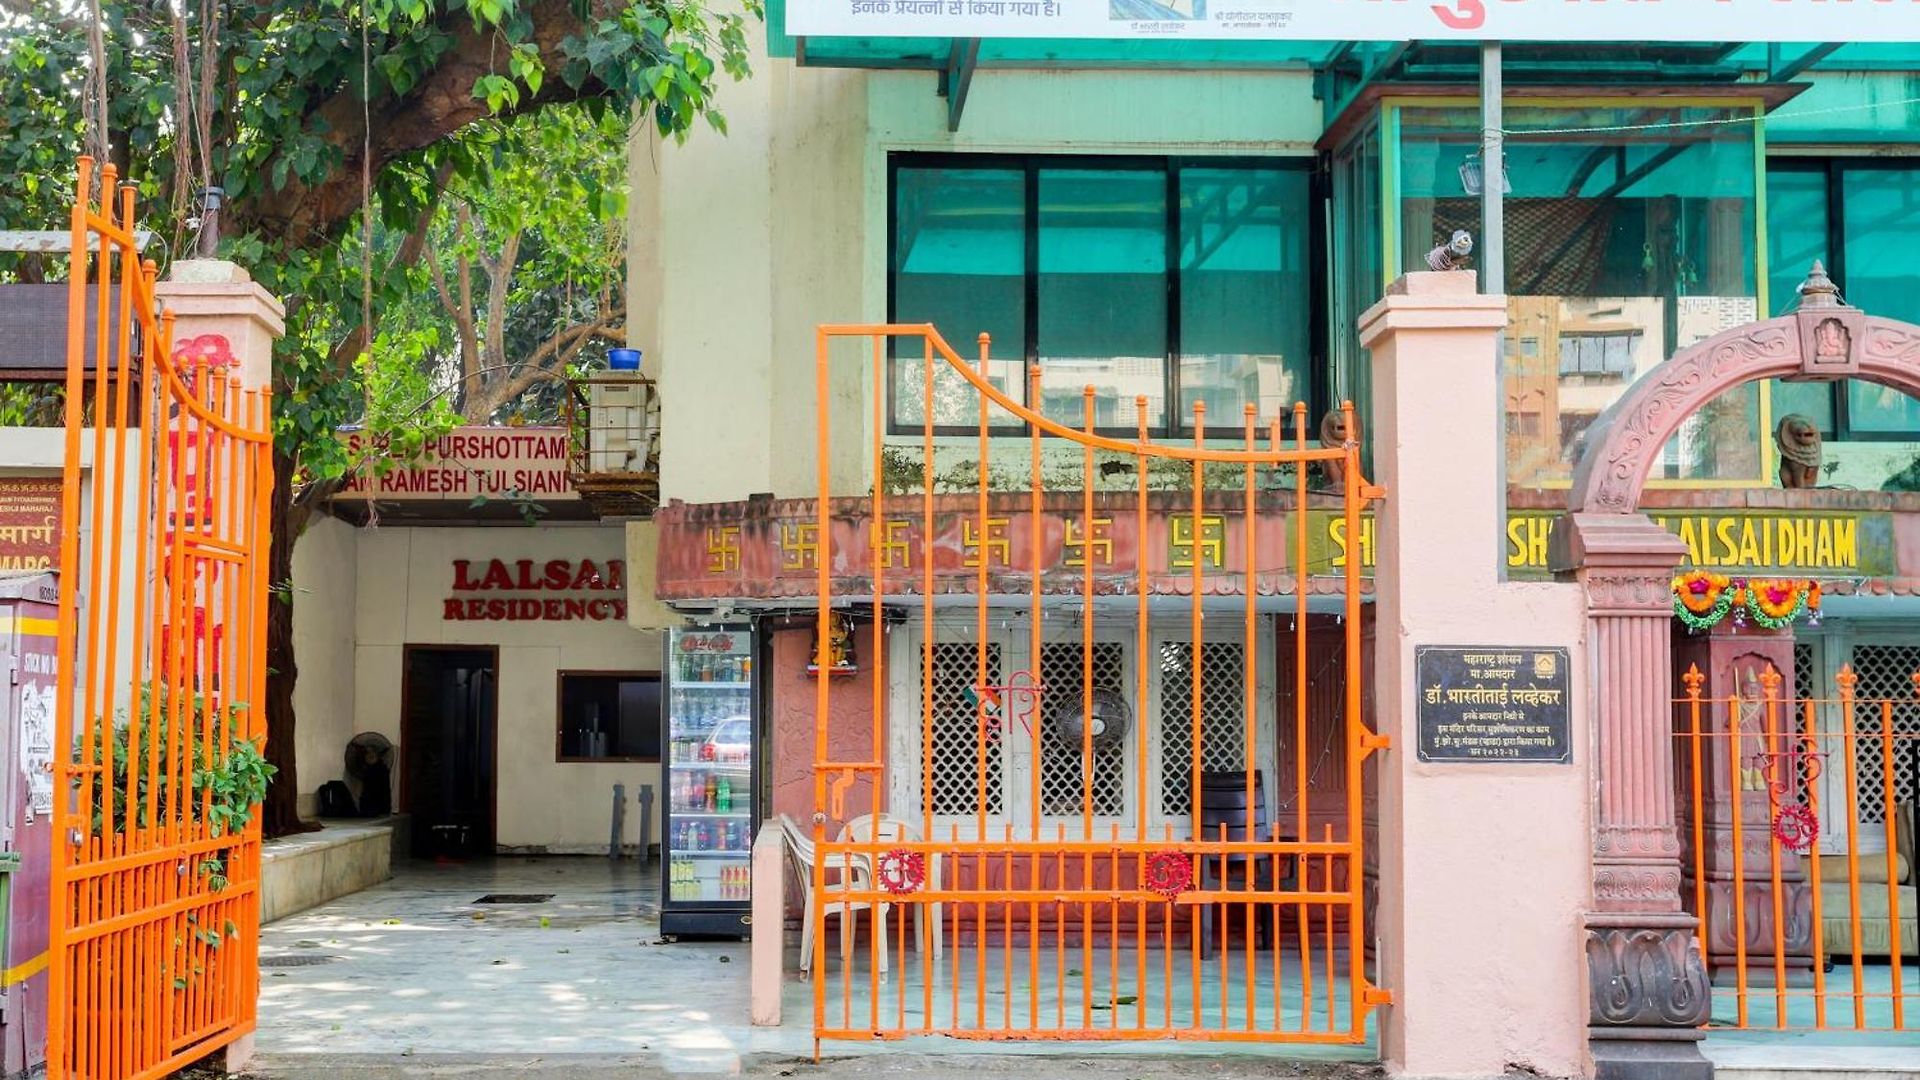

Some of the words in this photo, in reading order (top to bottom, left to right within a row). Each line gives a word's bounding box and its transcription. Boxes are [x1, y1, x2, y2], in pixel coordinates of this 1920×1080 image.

[381, 469, 467, 492] RAMESH
[452, 558, 625, 591] LALSAI
[443, 598, 627, 621] RESIDENCY
